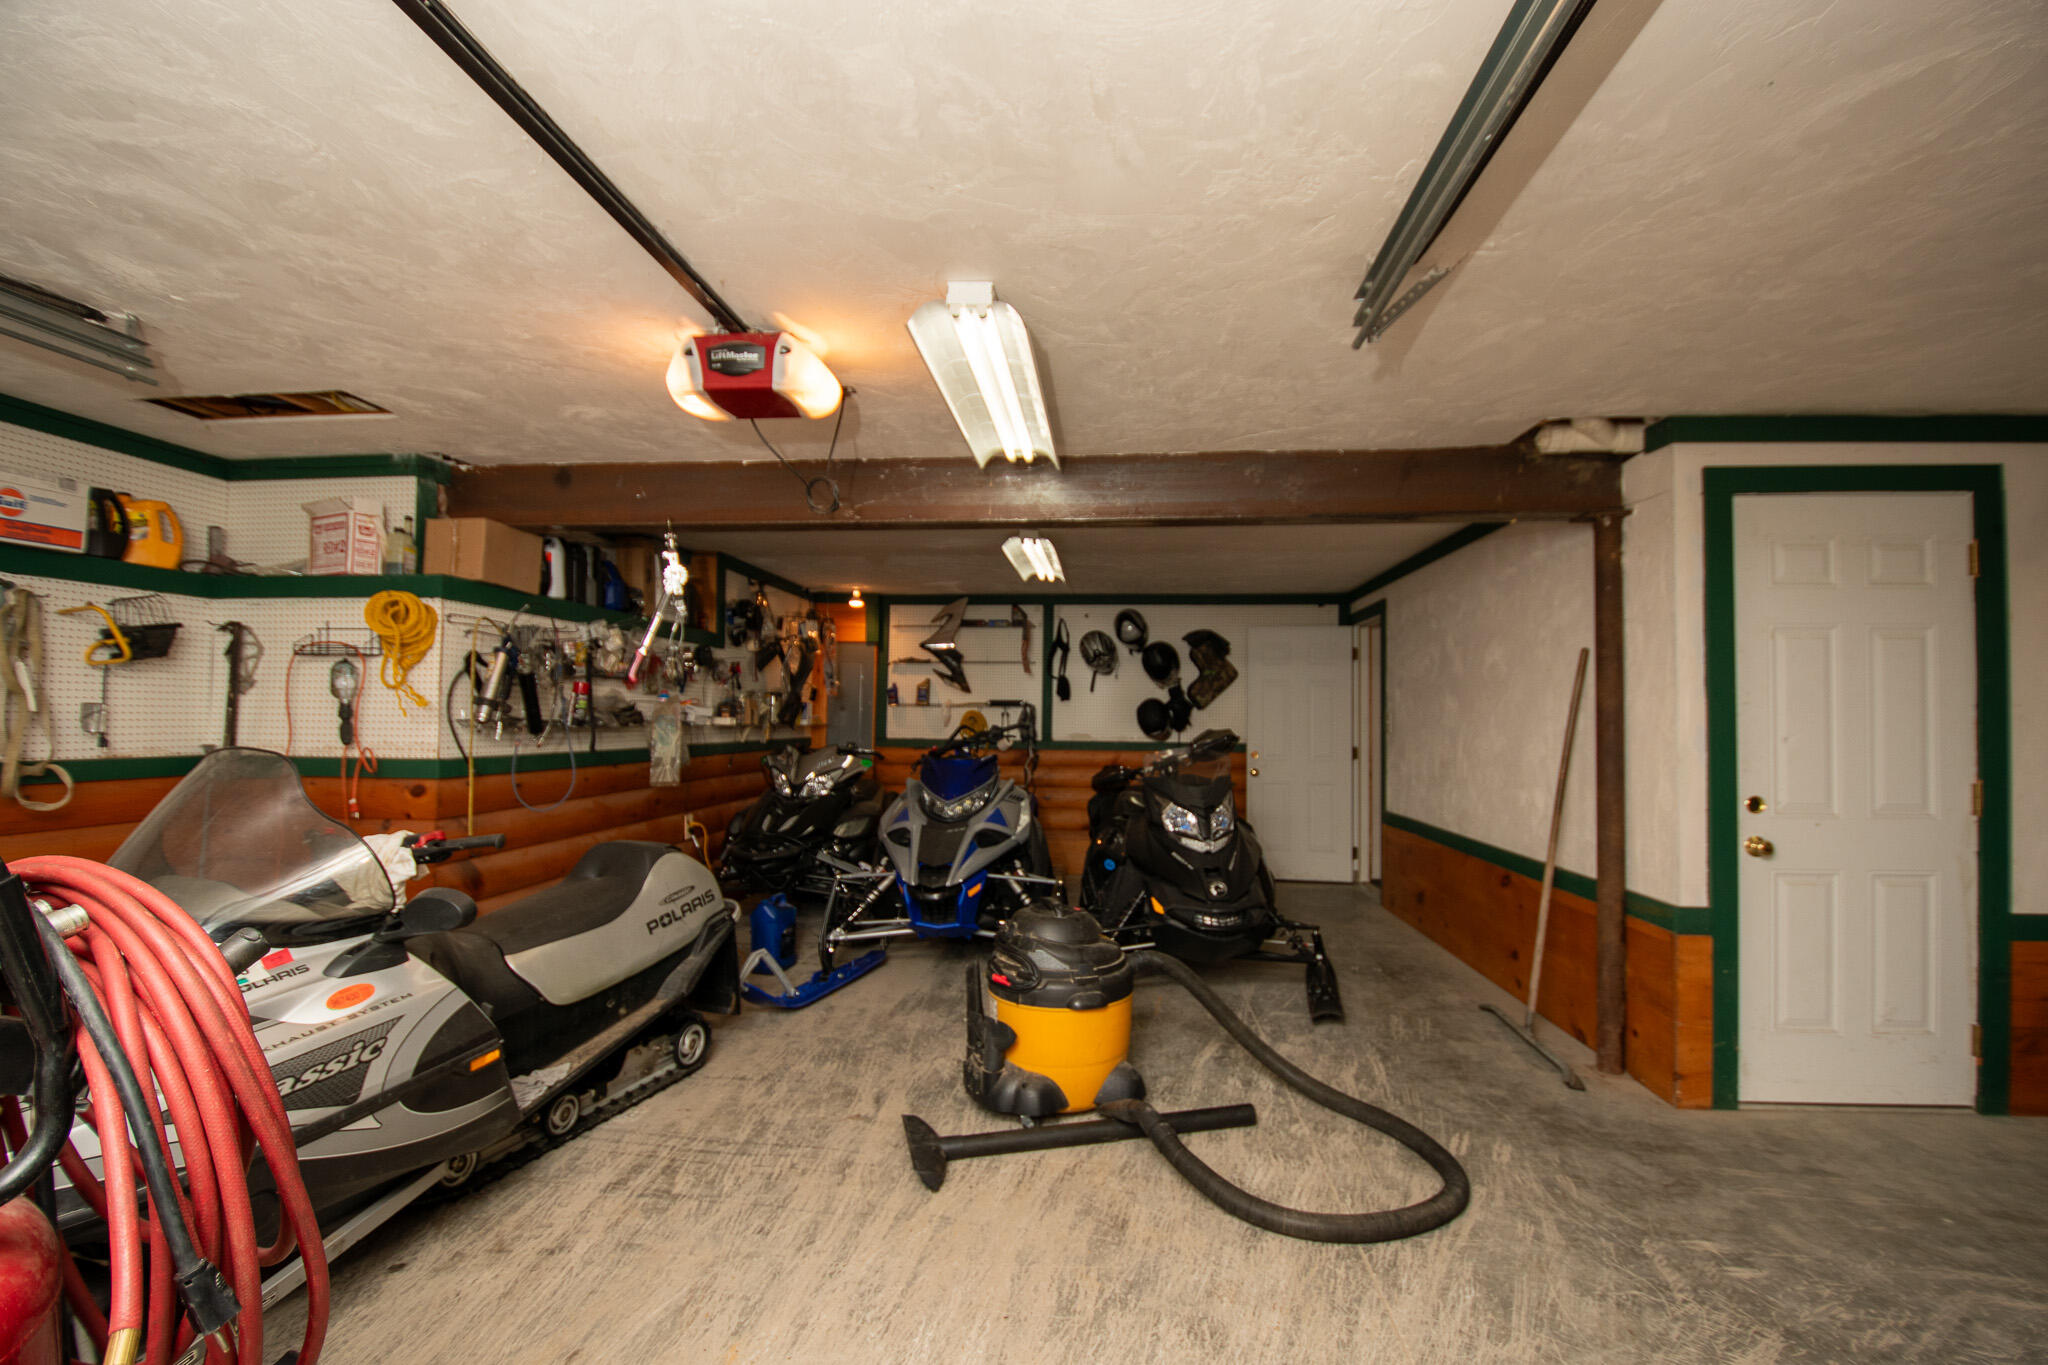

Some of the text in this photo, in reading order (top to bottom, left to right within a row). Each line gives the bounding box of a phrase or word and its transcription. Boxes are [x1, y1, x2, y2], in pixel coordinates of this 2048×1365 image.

[646, 888, 716, 935] POLARIS
[239, 963, 311, 993] OLARIS
[264, 1019, 338, 1051] HAUST
[347, 992, 414, 1021] SYSTEM
[276, 1036, 388, 1097] assic
